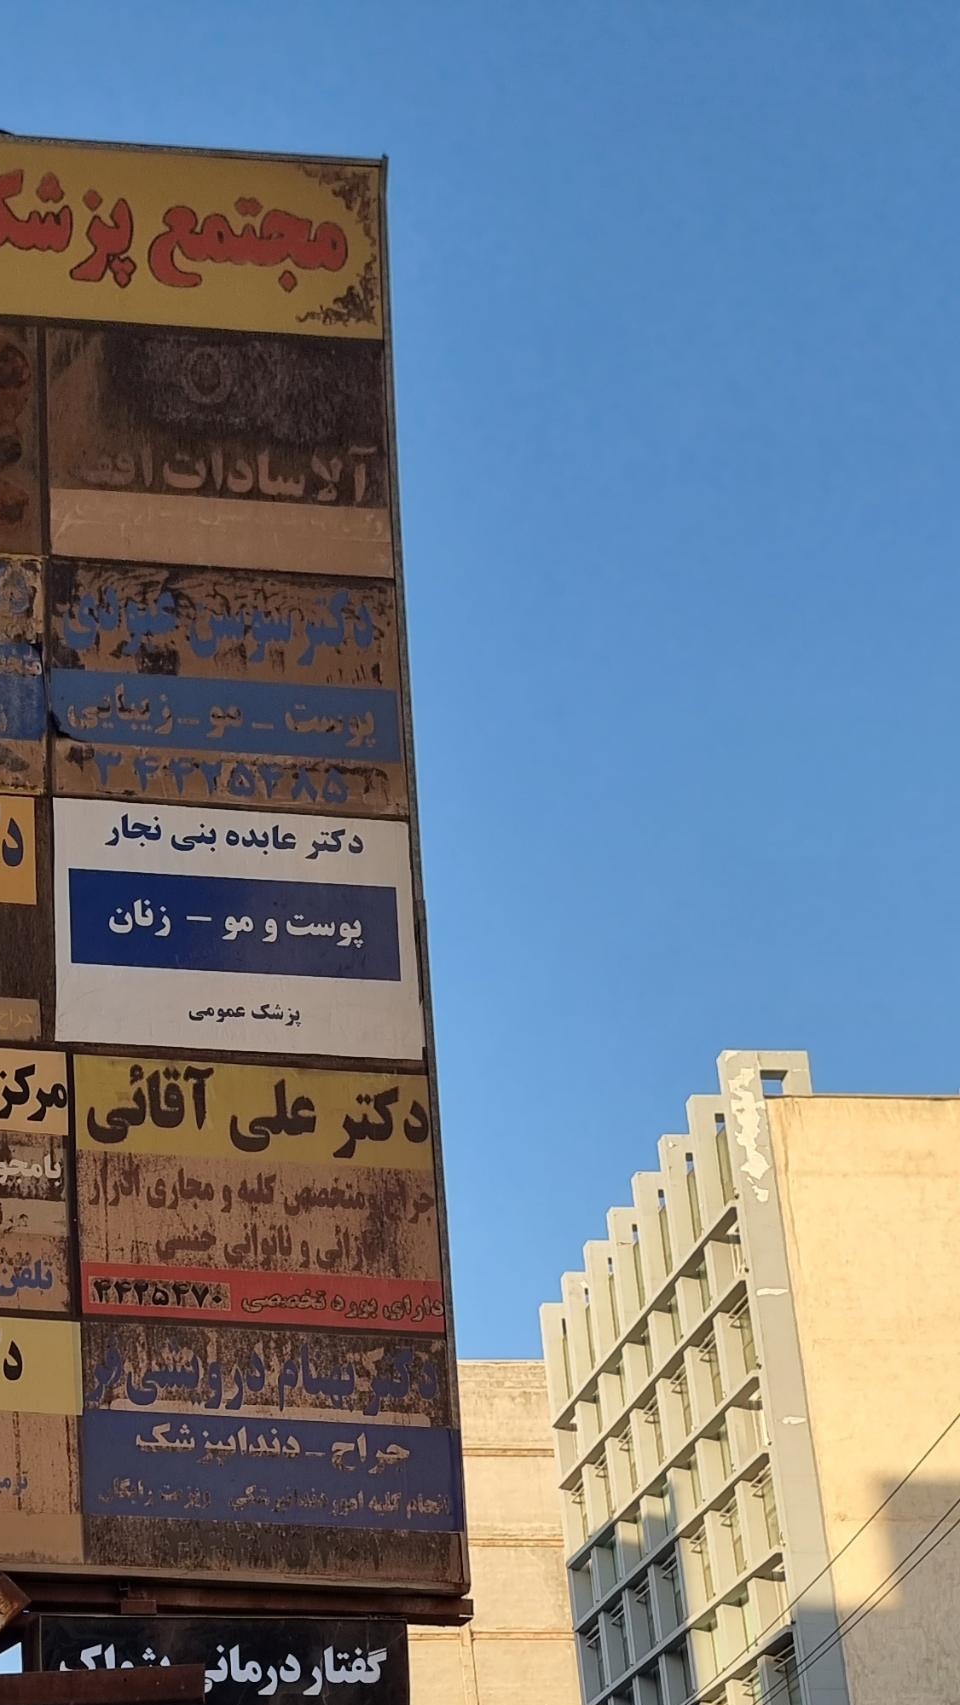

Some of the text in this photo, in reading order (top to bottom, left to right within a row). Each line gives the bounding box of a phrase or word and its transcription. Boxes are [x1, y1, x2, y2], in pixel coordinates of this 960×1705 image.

[147, 196, 348, 293] مجتمع
[284, 703, 376, 748] پوست
[105, 813, 364, 860] دکتر عابده بنی نجار
[108, 898, 363, 949] پوست و مو زنان
[188, 1003, 302, 1027] پزشک عمومی
[86, 1063, 430, 1160] دکتر علی آقائی
[145, 1167, 215, 1210] مجاری
[241, 1288, 327, 1312] تخصصی
[302, 1645, 388, 1696] گفتار
